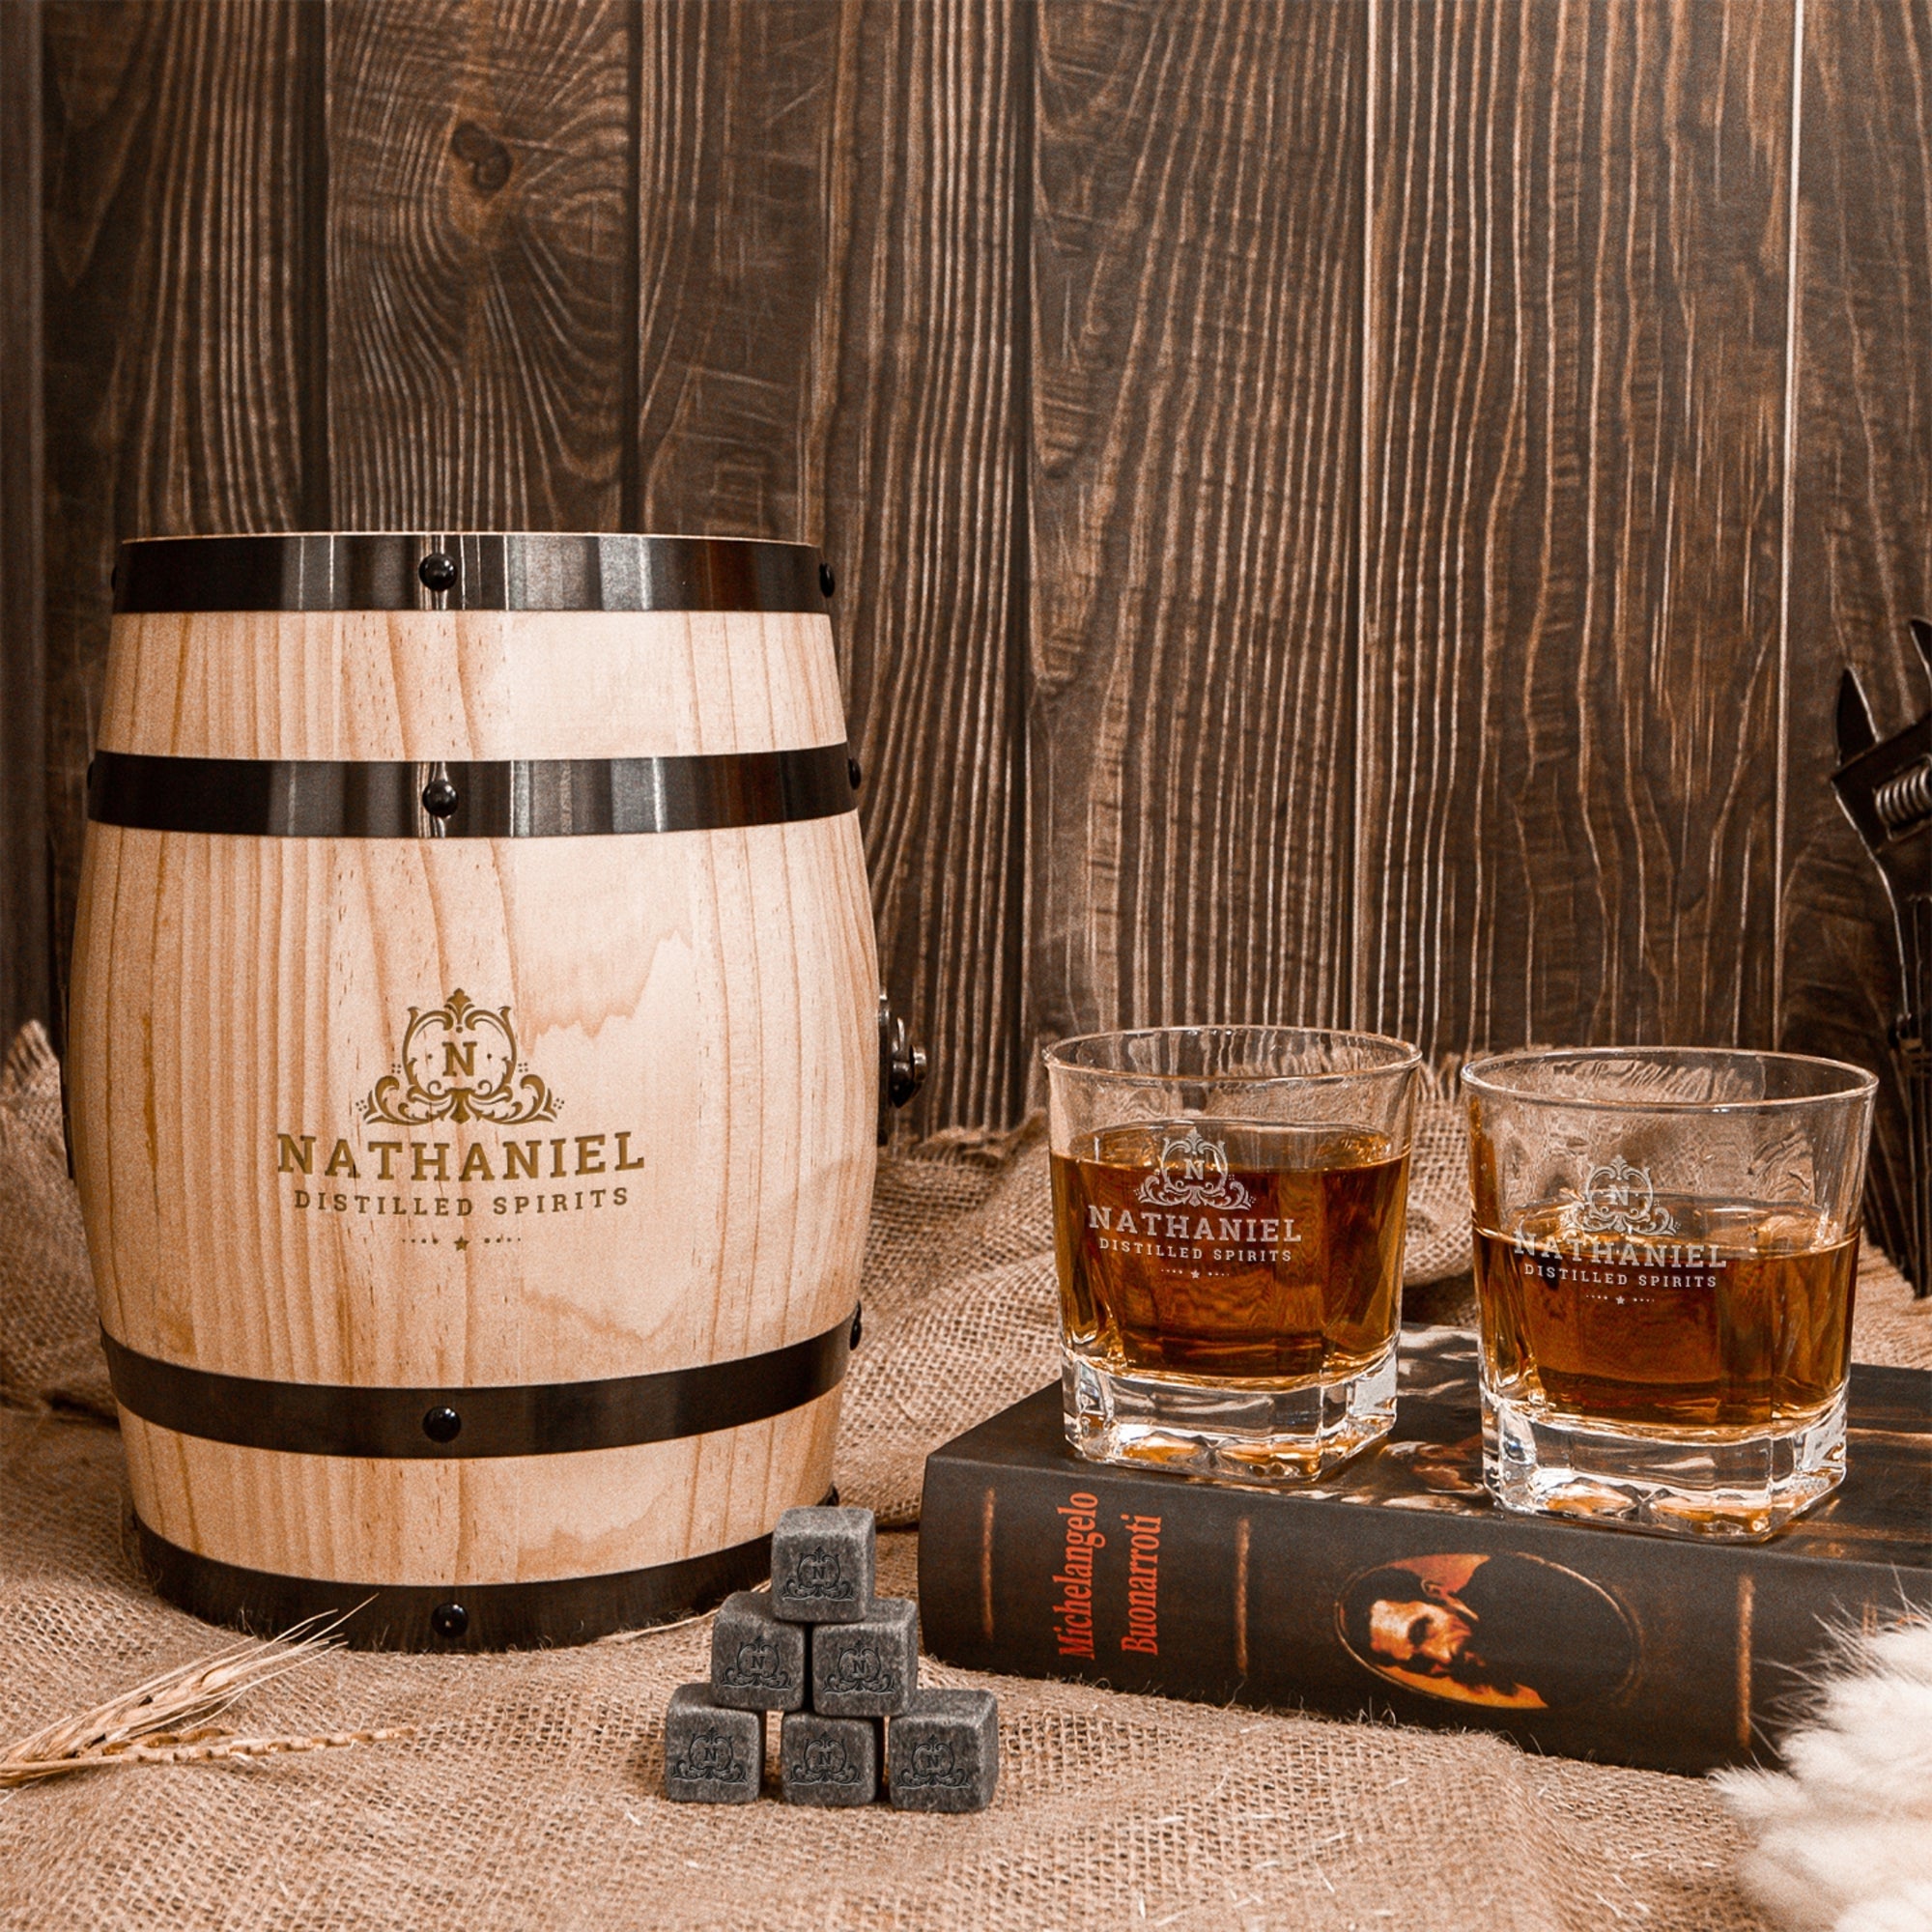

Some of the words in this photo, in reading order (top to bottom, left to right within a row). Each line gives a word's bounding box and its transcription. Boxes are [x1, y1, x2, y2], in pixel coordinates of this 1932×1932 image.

[442, 1041, 477, 1077] N
[277, 1131, 645, 1182] NATHANIEL
[1184, 1158, 1205, 1180] N
[295, 1189, 473, 1217] DISTILLED
[493, 1187, 629, 1215] SPIRITS
[1608, 1184, 1630, 1207] N
[1088, 1205, 1302, 1243] NATHANIEL
[1099, 1236, 1204, 1260] DISTILLED
[1213, 1248, 1292, 1262] SPIRITS
[1513, 1230, 1727, 1268] NATHANIEL
[1524, 1264, 1629, 1286] DISTILLED
[1638, 1275, 1717, 1288] SPIRITS
[812, 1566, 827, 1580] N
[1052, 1492, 1106, 1661] Michelangelo
[1121, 1513, 1162, 1656] Buonarroti
[751, 1655, 765, 1669] N
[853, 1659, 867, 1674] N
[703, 1747, 718, 1761] N
[818, 1751, 833, 1766] N
[926, 1754, 941, 1769] N
